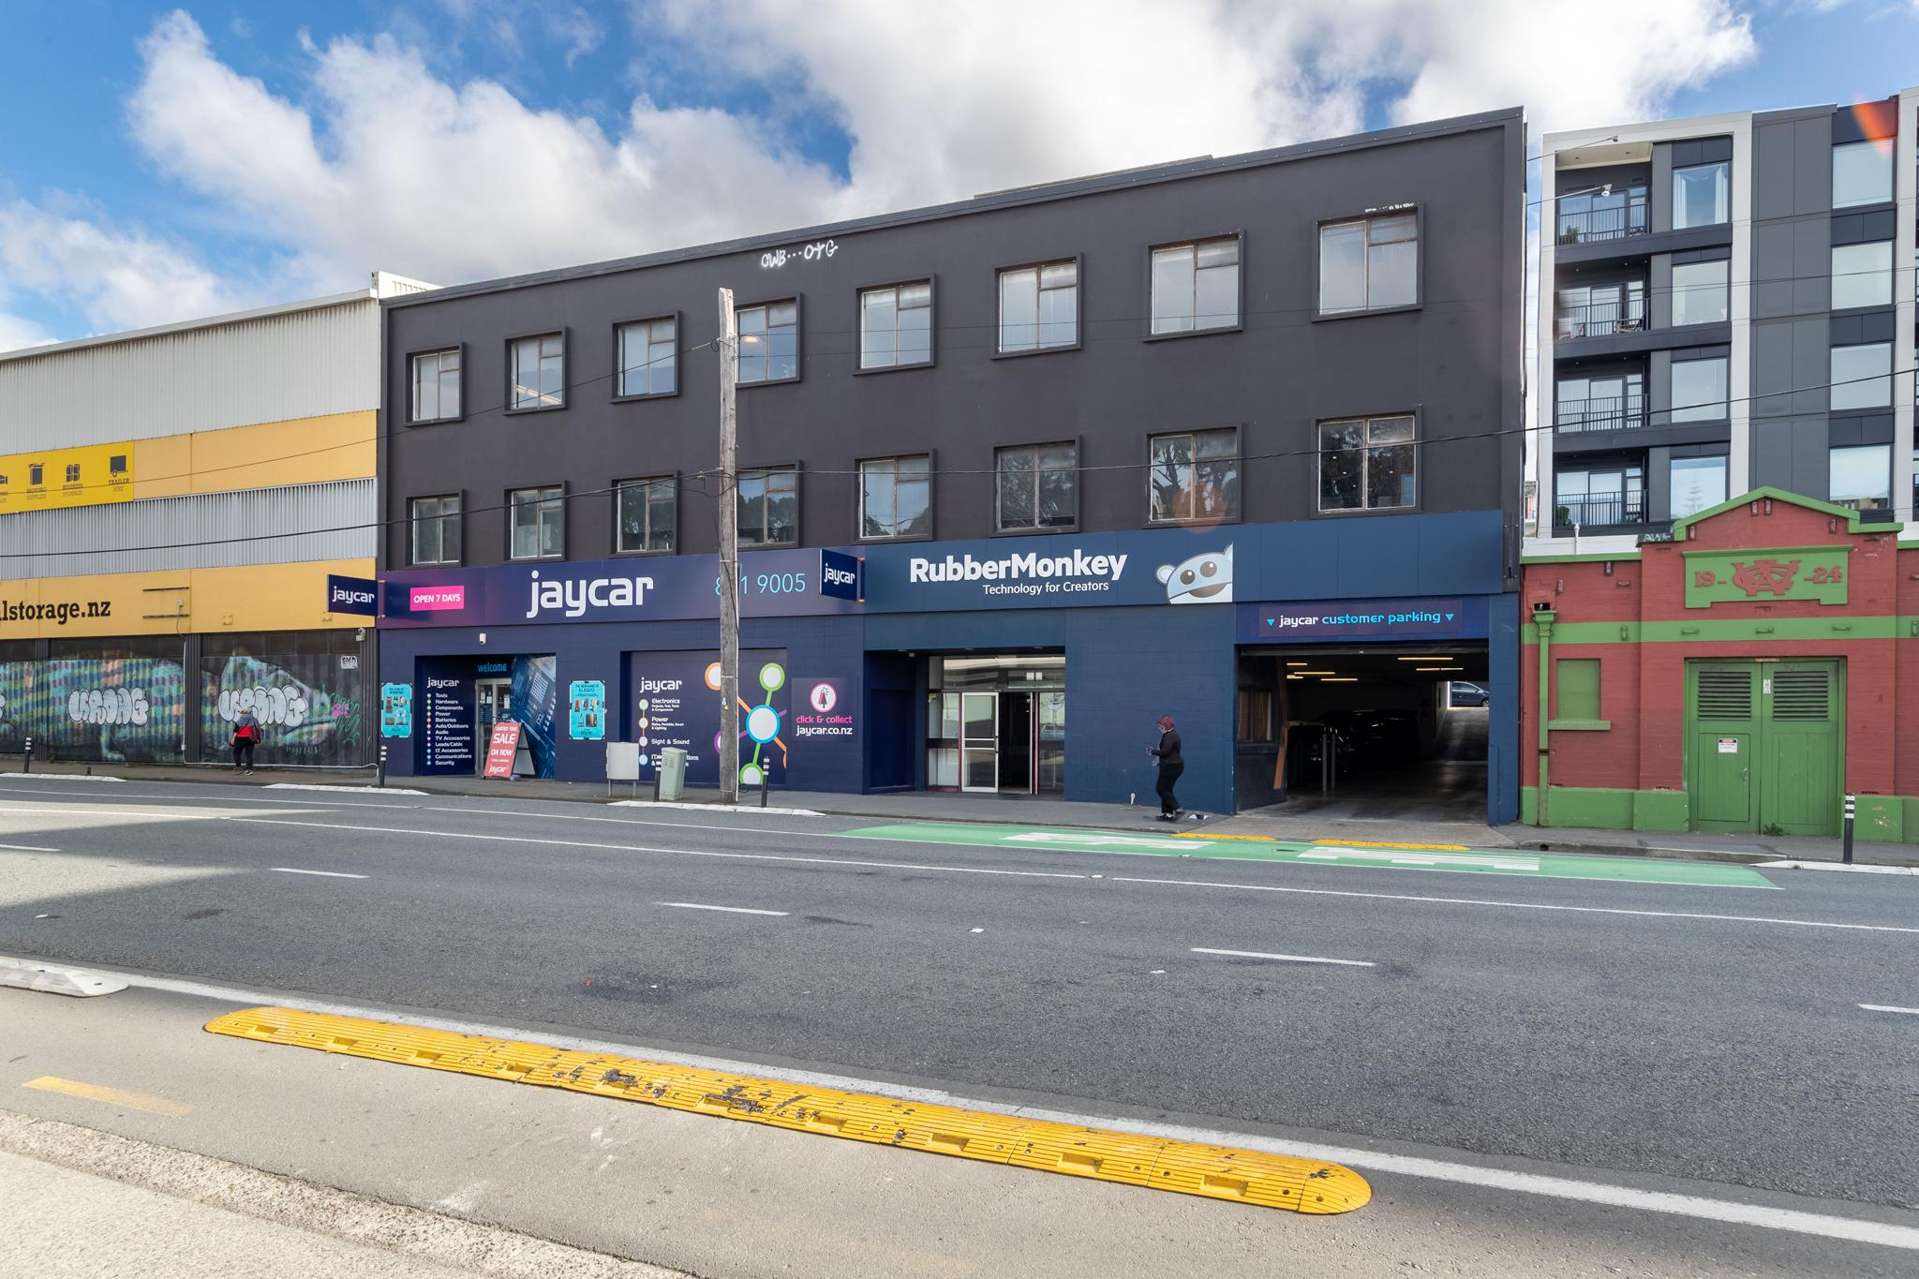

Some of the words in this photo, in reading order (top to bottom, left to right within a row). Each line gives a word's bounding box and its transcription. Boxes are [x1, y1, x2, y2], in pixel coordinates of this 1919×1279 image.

[910, 549, 1128, 582] RubberMonkey
[824, 563, 856, 585] jaycar
[757, 573, 806, 594] 9005
[982, 584, 1042, 595] Technology
[1045, 582, 1061, 593] for
[1063, 581, 1109, 592] Creators
[332, 586, 375, 604] jaycar
[413, 594, 435, 604] OPEN
[436, 594, 441, 603] 7
[441, 593, 462, 603] DAYS
[526, 570, 654, 618] jaycar
[0, 600, 111, 625] lstorage.nz
[1279, 615, 1319, 628] jaycar
[1321, 612, 1385, 624] customer
[1388, 611, 1441, 624] parking
[427, 677, 460, 688] jaycar
[640, 677, 682, 693] jaycar
[796, 715, 815, 724] click
[826, 715, 852, 724] collect
[493, 733, 516, 744] SALE
[796, 725, 853, 737] jaycar.co.nz
